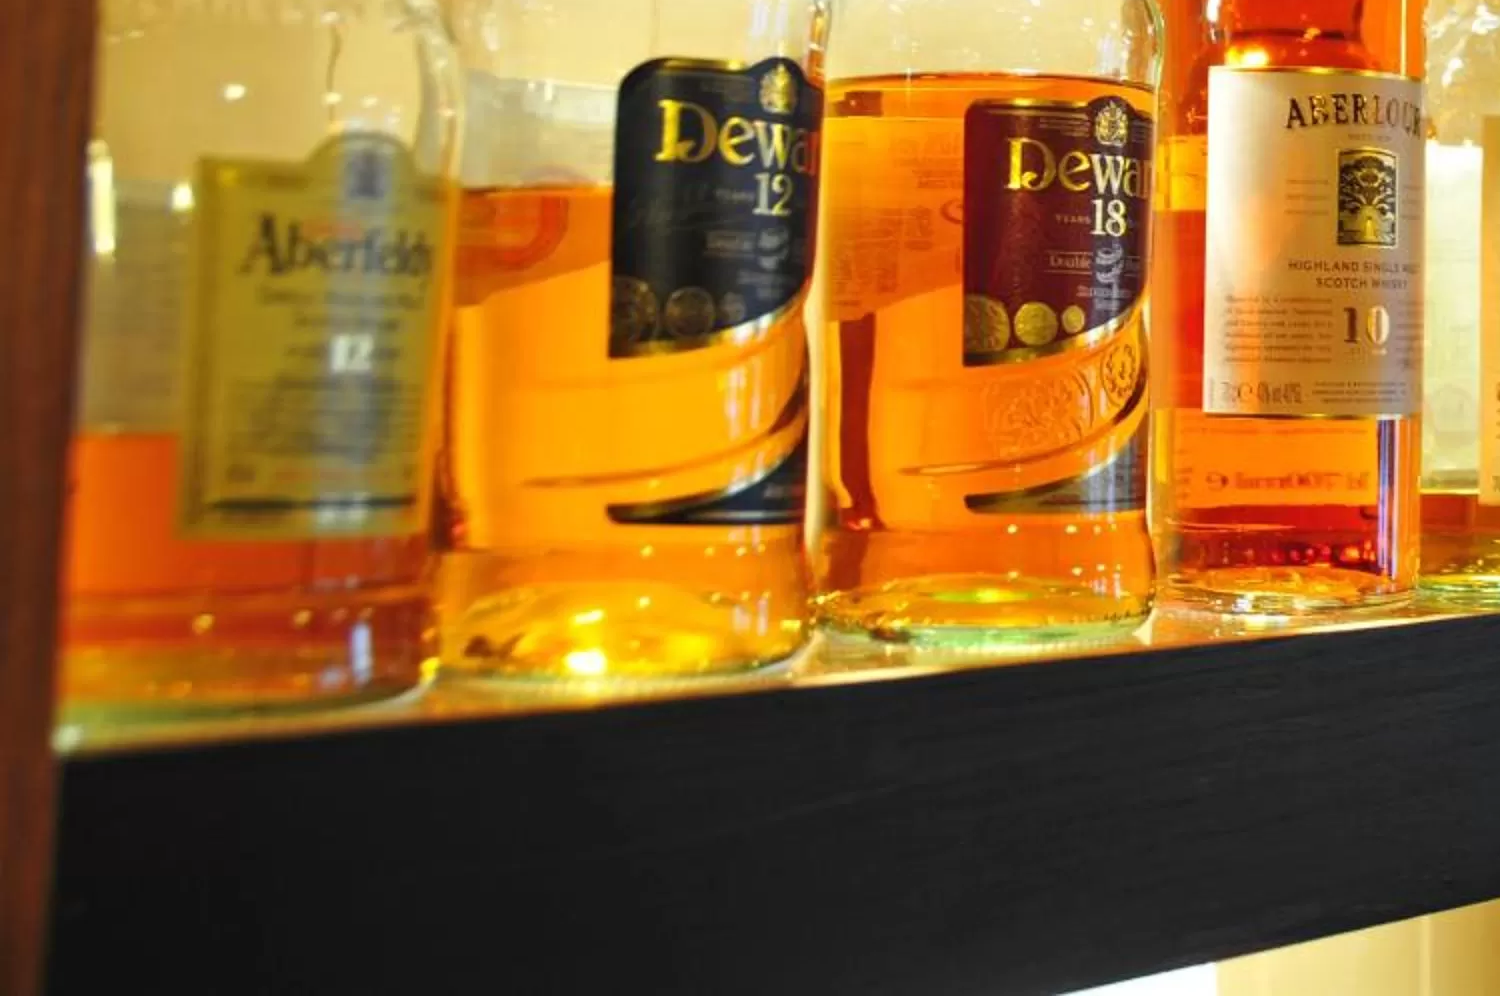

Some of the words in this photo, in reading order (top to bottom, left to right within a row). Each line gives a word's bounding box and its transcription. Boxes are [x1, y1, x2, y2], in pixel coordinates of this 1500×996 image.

[752, 172, 793, 216] 12
[1090, 199, 1127, 237] 18
[1287, 259, 1360, 273] HIGHLAND
[1315, 276, 1368, 289] SCOTCH
[1342, 306, 1390, 346] 10
